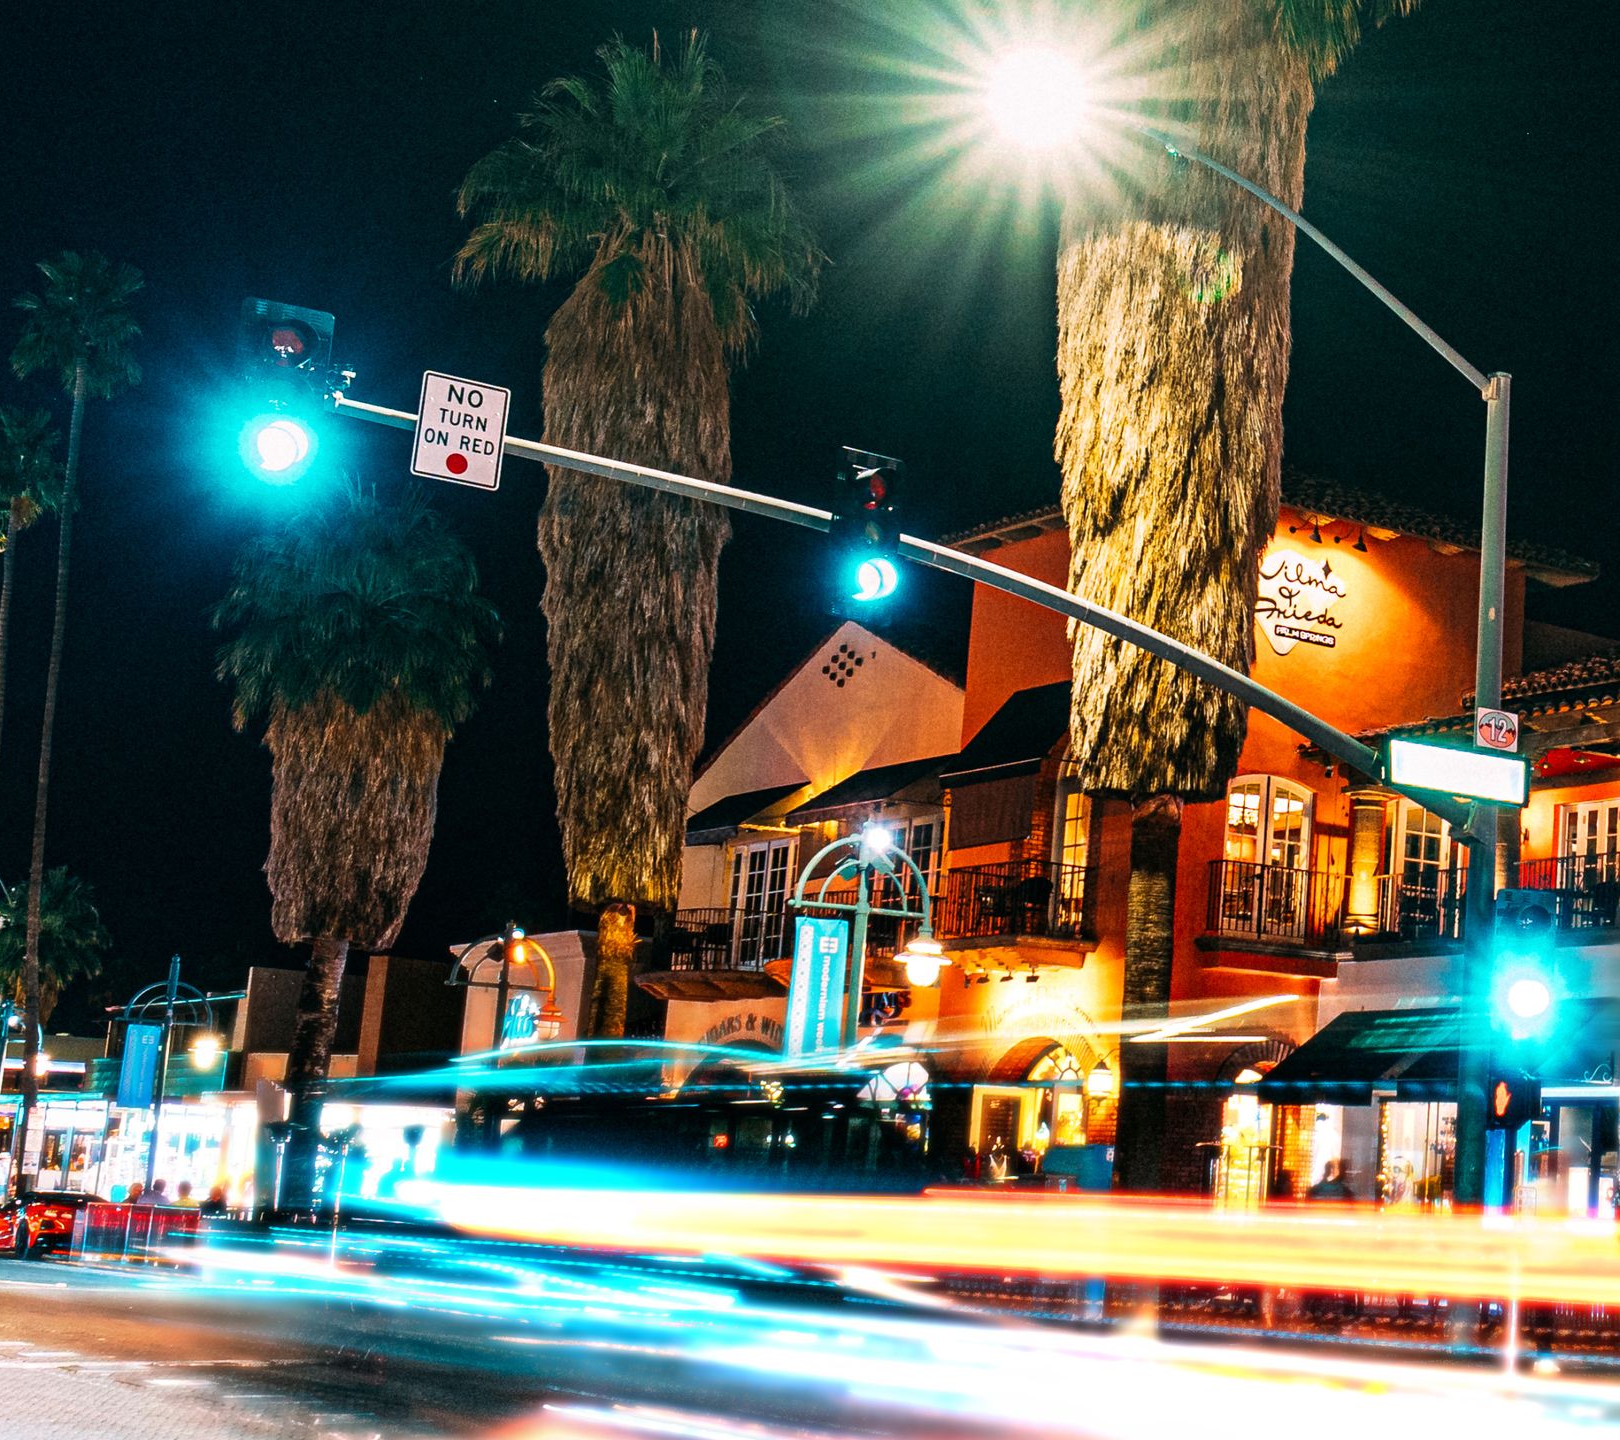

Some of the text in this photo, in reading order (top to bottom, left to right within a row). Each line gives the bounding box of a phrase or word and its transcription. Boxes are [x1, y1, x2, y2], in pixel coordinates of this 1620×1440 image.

[447, 384, 484, 408] NO
[440, 408, 487, 432] TURN
[424, 428, 495, 455] ON RED
[1278, 586, 1300, 607] &
[1276, 626, 1334, 645] PALM SPRINGS
[1489, 717, 1507, 743] 12
[818, 955, 831, 1021] modernism
[746, 1013, 757, 1031] &
